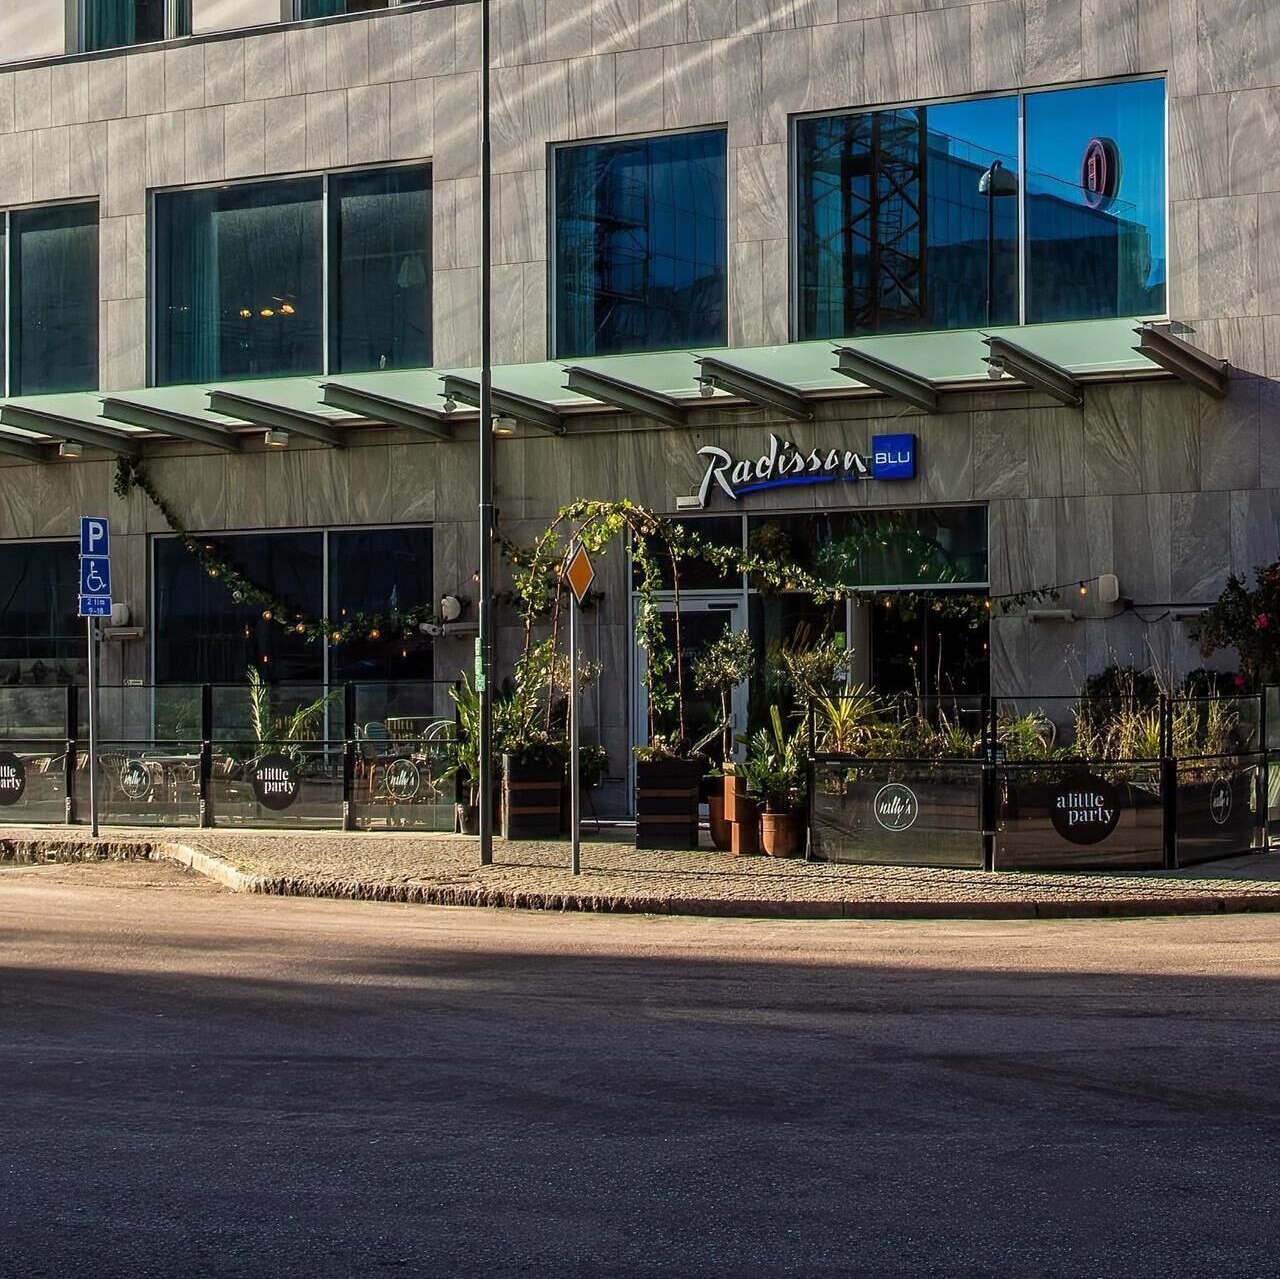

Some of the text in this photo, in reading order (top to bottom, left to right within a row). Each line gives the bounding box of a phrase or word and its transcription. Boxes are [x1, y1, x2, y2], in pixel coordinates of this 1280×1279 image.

[697, 433, 910, 507] Radisson BLU
[89, 522, 104, 552] P
[264, 767, 289, 780] little
[264, 780, 296, 794] party
[1068, 792, 1104, 808] little
[1068, 807, 1114, 825] party
